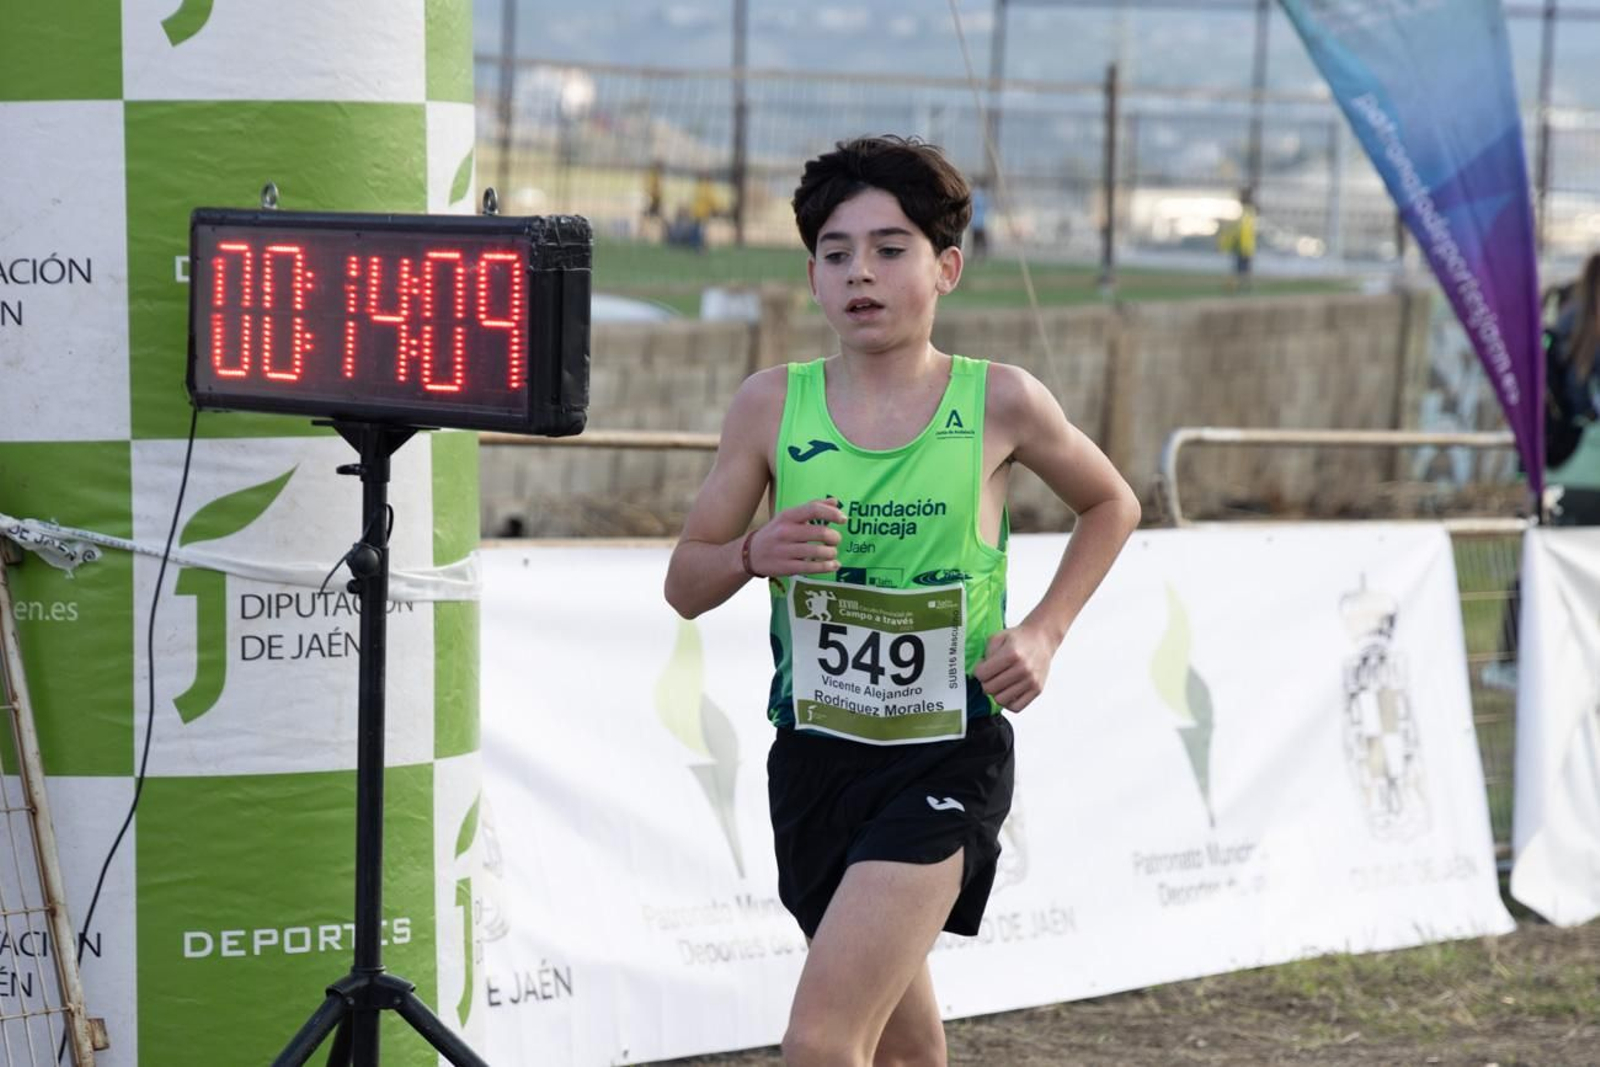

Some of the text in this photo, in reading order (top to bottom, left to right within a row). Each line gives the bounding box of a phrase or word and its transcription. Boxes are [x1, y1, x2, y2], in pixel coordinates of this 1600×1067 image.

[212, 242, 524, 393] 00:14:09
[848, 499, 946, 517] Fundación
[847, 518, 917, 540] Unicaja
[846, 541, 876, 554] Jaén
[838, 608, 873, 621] Campo
[882, 615, 914, 626] través
[241, 634, 285, 661] DE
[817, 623, 925, 687] 549
[948, 656, 958, 690] SUB16
[821, 674, 923, 702] Vicente Alejandro
[884, 699, 945, 717] Morales
[508, 958, 574, 1004] JAÉN
